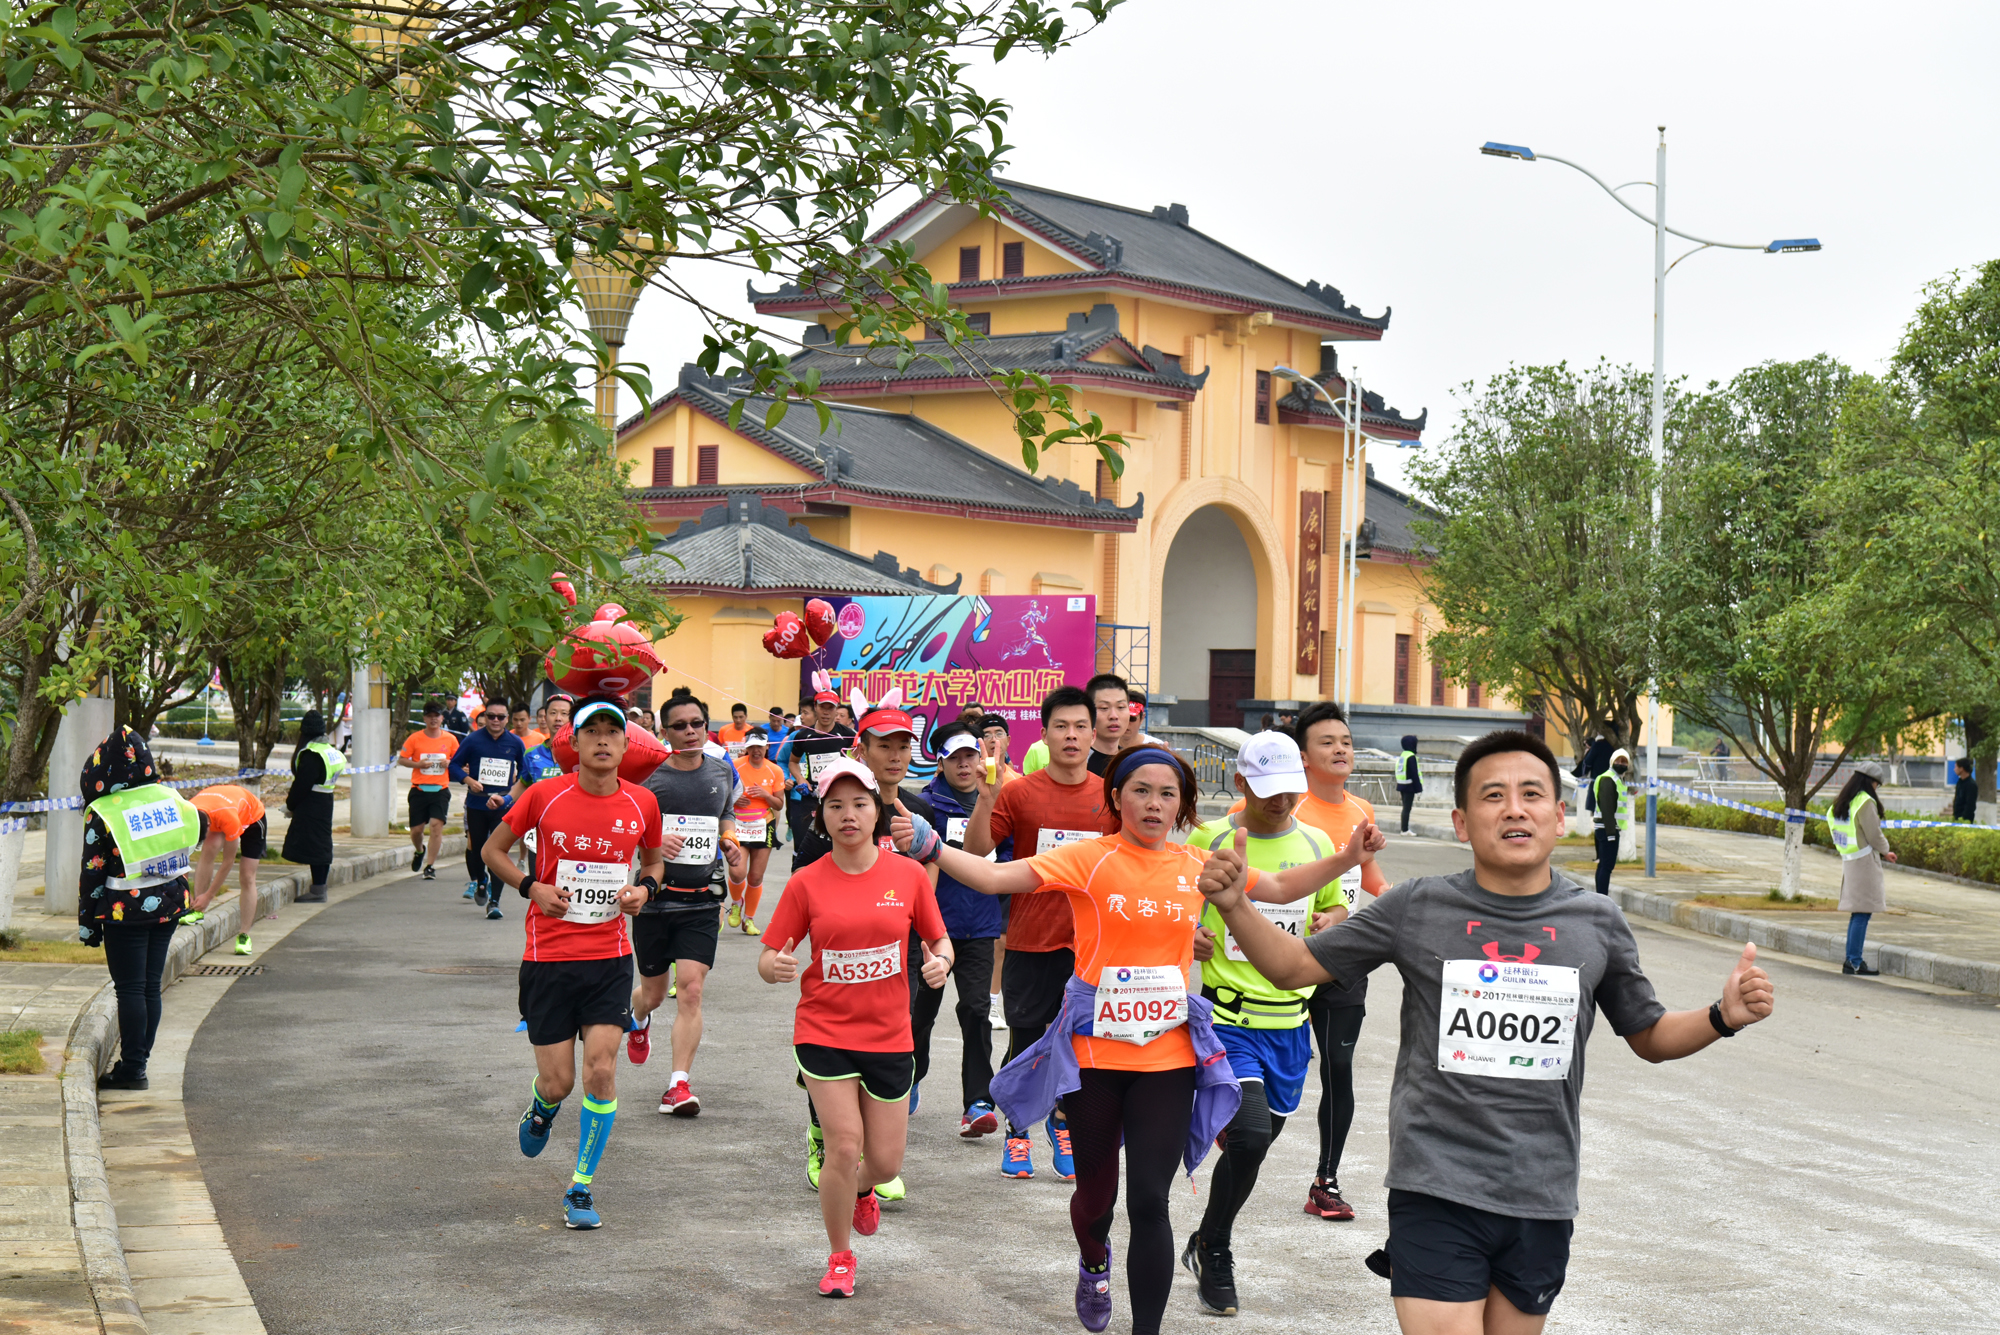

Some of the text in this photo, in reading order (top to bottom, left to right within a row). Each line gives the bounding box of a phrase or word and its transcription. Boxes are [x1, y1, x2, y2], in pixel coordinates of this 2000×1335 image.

[774, 622, 800, 654] 4:00
[480, 768, 506, 778] A0068
[128, 805, 178, 832] 综合执法
[551, 831, 612, 855] 霞客行
[144, 852, 188, 878] 文明雁山
[1106, 893, 1184, 922] 霞客行
[827, 957, 893, 981] A5323
[1502, 976, 1548, 986] GUILIN BANK
[1503, 966, 1539, 977] 桂林银行
[1098, 1000, 1177, 1022] A5092
[1447, 1007, 1562, 1045] A0602
[1467, 1055, 1496, 1063] HUAWEI
